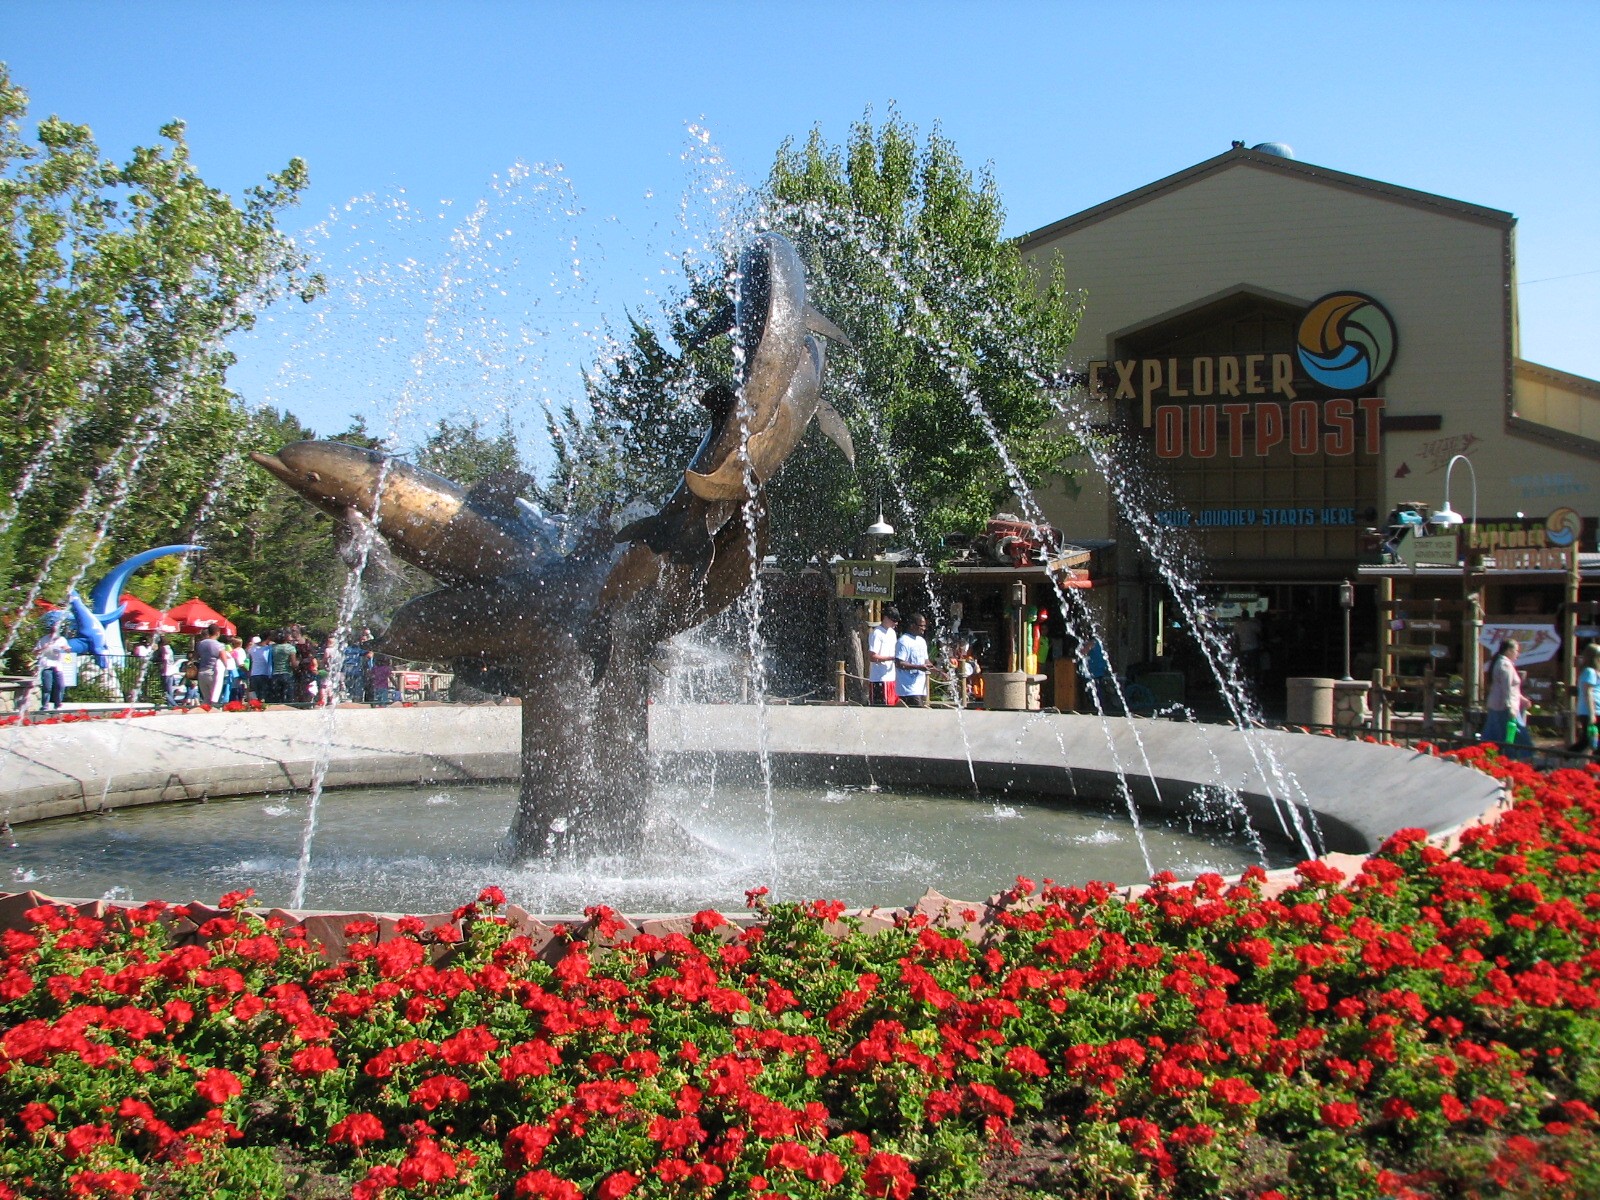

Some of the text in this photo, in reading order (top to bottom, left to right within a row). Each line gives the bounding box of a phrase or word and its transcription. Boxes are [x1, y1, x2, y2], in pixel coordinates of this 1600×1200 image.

[1088, 353, 1298, 428] EXPLORER
[1155, 397, 1386, 459] OUTPOST
[1195, 508, 1257, 527] JOURNEY
[1262, 508, 1315, 527] STARTS
[1320, 507, 1356, 526] HERE
[852, 566, 872, 577] Guest
[856, 580, 887, 594] Relations
